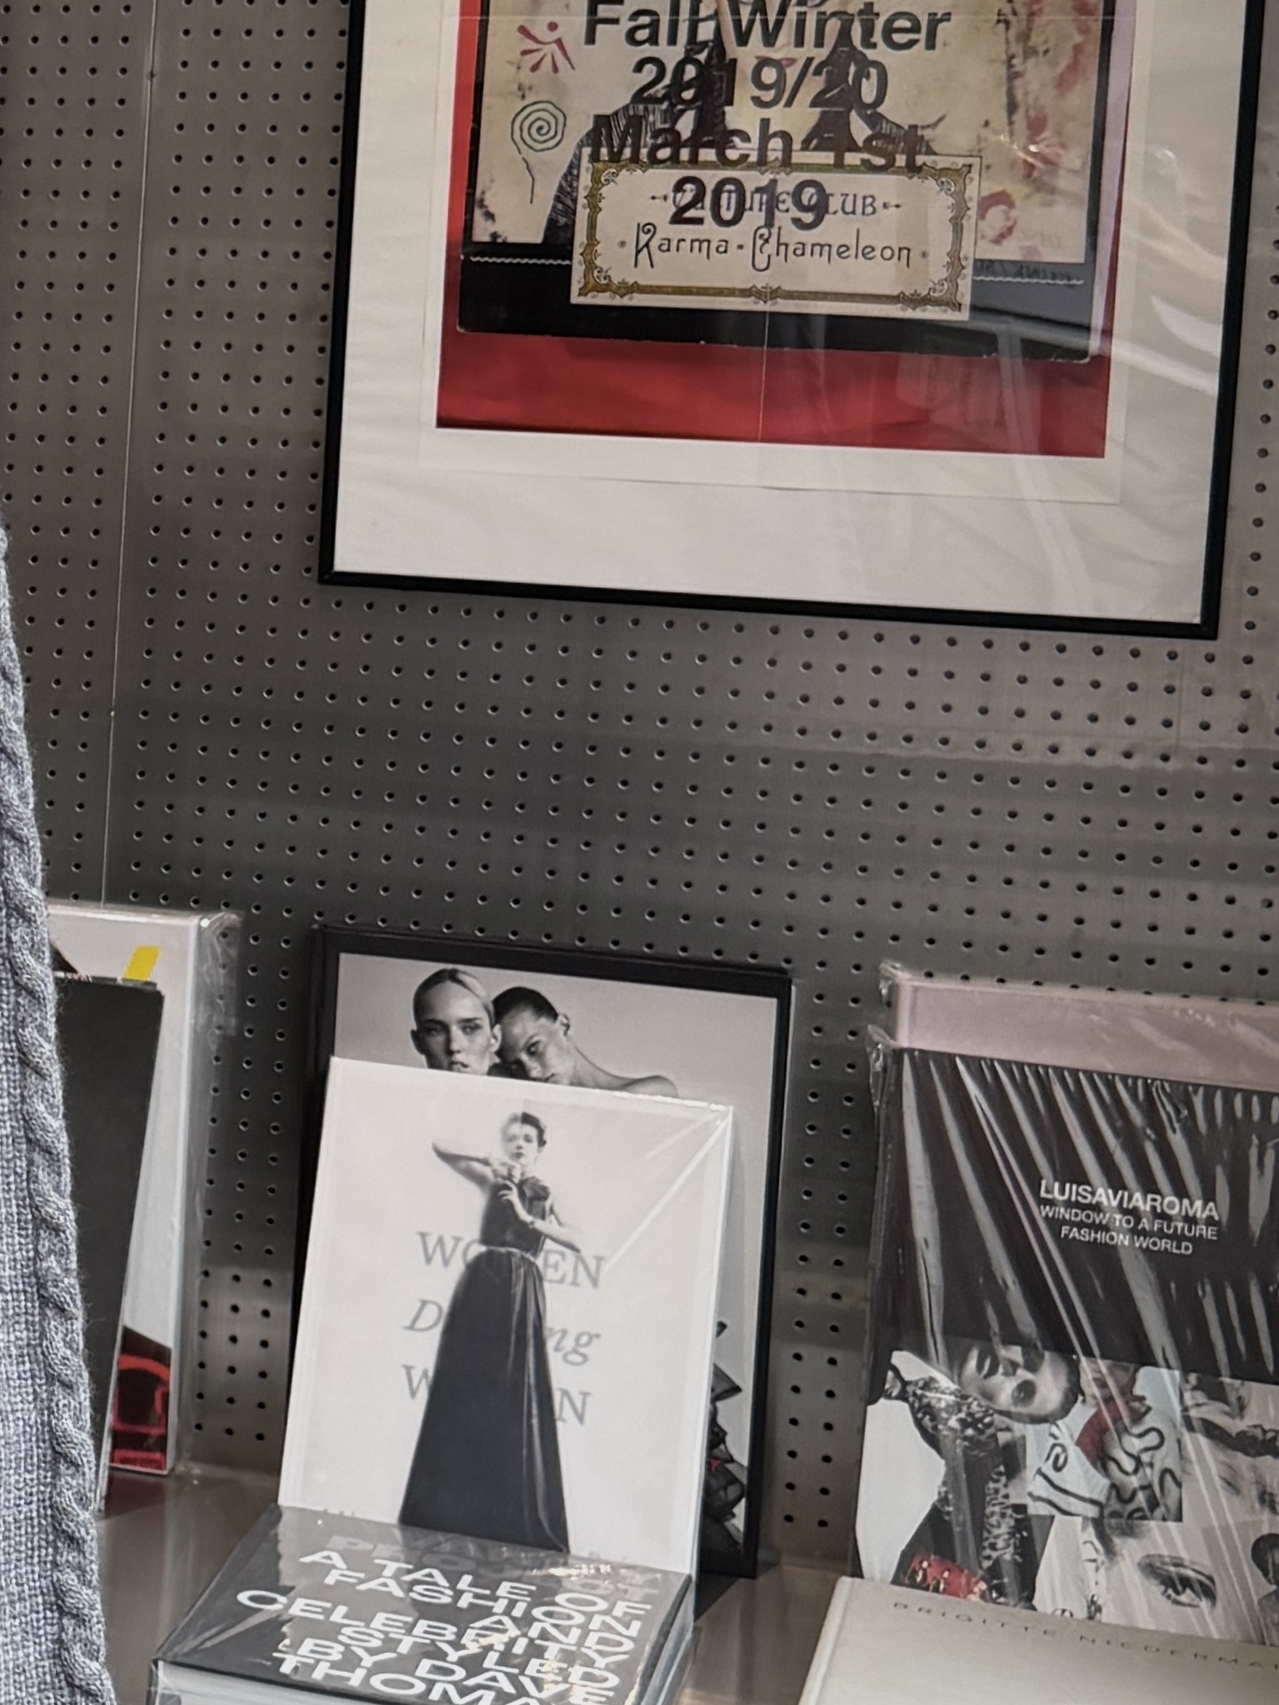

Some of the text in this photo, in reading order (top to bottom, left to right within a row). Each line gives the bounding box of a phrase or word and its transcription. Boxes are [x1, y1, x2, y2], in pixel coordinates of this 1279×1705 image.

[630, 56, 888, 110] 2019/20
[591, 114, 793, 168] March
[669, 175, 827, 230] 2019
[634, 222, 911, 272] Karma Chameleon
[1040, 1180, 1220, 1221] LUISAVIAROMA
[1040, 1205, 1219, 1240] WINDOW TO A FUTURE
[1060, 1225, 1193, 1255] FASHION WORLD
[299, 1551, 652, 1620] A TALE OF
[324, 1569, 642, 1638] FASHION
[237, 1590, 630, 1668] CELEBRITY
[470, 1615, 634, 1653] AND
[894, 1601, 1056, 1636] BRIGITTE
[297, 1638, 400, 1669] BY
[339, 1627, 619, 1689] STYLED
